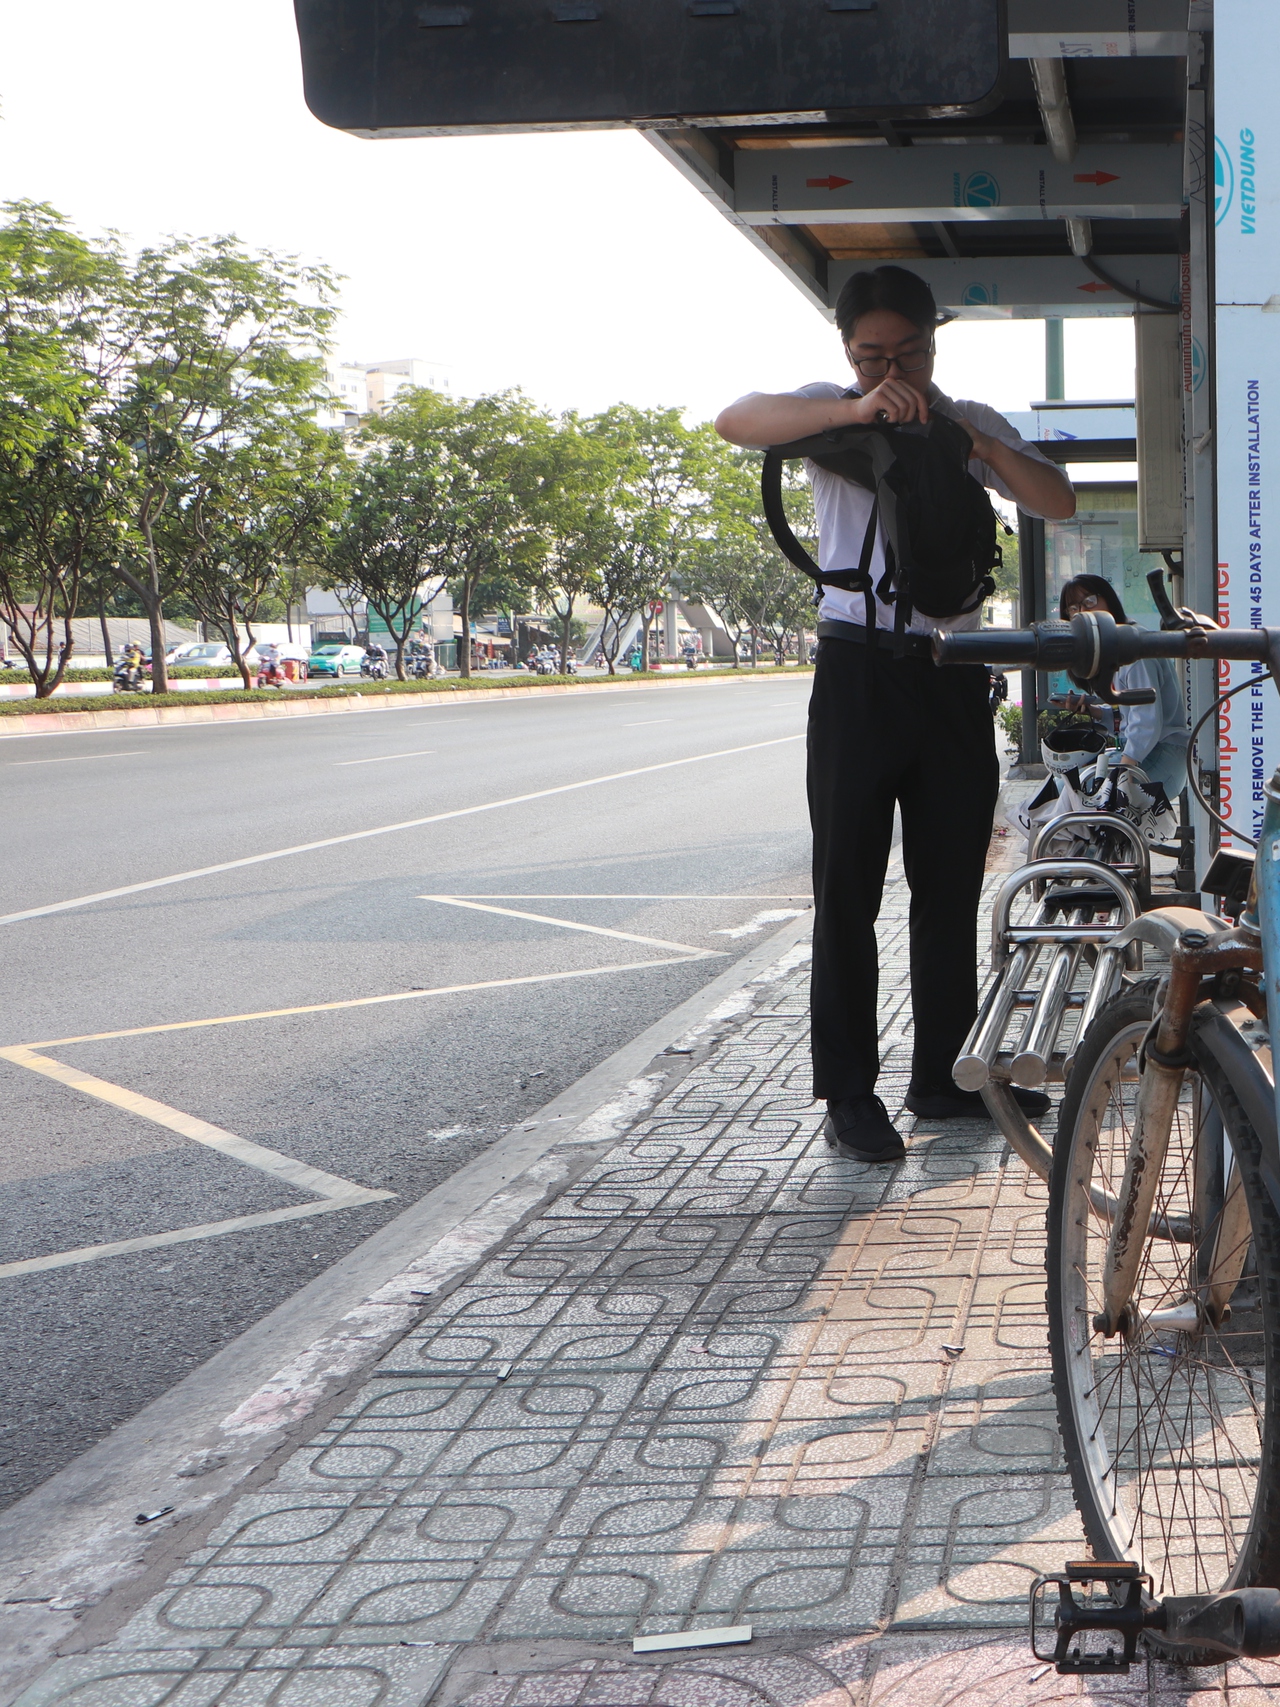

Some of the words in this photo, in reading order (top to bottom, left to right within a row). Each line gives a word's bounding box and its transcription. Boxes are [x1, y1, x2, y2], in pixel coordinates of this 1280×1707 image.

[953, 172, 961, 208] VIETDU
[1239, 127, 1256, 235] VIETDUNG
[1247, 379, 1261, 487] INSTALLATION
[1248, 489, 1262, 539] AFTER
[1249, 542, 1262, 583] DAYS
[1250, 585, 1263, 604] 45
[1251, 701, 1264, 733] THE
[1251, 736, 1264, 799] REMOVE
[1252, 805, 1265, 843] NLY.
